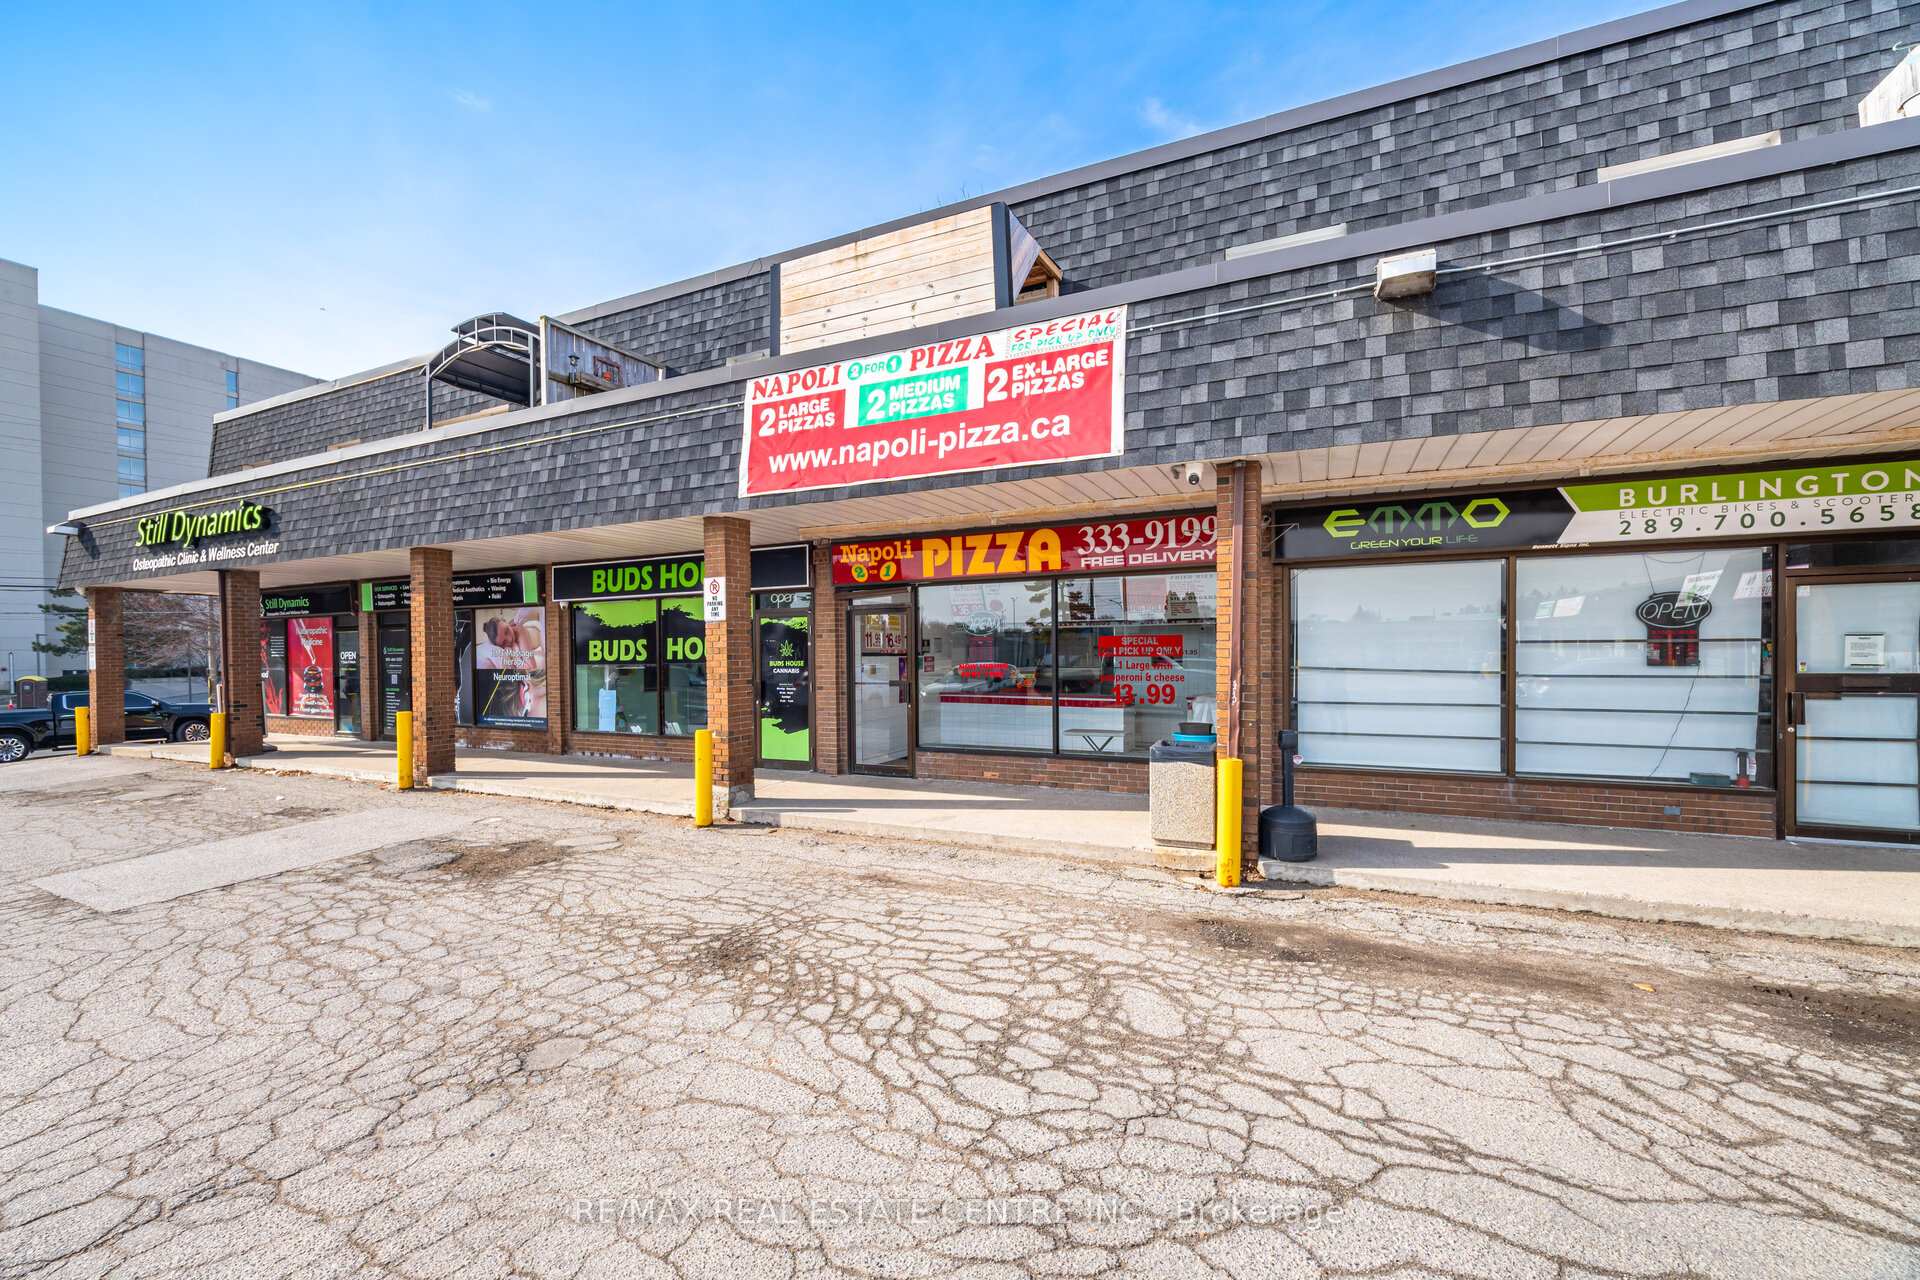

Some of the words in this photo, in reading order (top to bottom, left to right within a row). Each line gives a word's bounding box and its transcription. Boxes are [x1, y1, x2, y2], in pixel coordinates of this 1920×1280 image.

[1013, 312, 1117, 342] SPECIAL
[1037, 336, 1063, 347] PICK
[752, 364, 841, 401] NAPOLI
[864, 361, 886, 374] FOR
[909, 335, 995, 372] PIZZA
[1012, 348, 1109, 381] EX-LARGE
[889, 374, 961, 401] MEDIUM
[987, 368, 1009, 402] 2
[1011, 370, 1085, 399] PIZZAS
[778, 397, 831, 419] LARGE
[866, 388, 887, 421] 2
[888, 392, 955, 417] PIZZAS
[758, 407, 777, 438] 2
[777, 411, 836, 434] PIZZAS
[768, 413, 1071, 474] www.napoli-pizza.ca
[1619, 468, 1920, 507] BURLINGTON
[1322, 498, 1511, 538] EMMO
[1619, 505, 1708, 519] ELECTRIC
[1721, 502, 1777, 514] BIKES
[1790, 500, 1799, 510] &
[1619, 503, 1920, 536] 289.700.5658
[135, 513, 168, 547] Still
[170, 500, 262, 548] Dynamics
[1077, 515, 1218, 555] 333-9199
[839, 540, 915, 567] Napoli
[922, 528, 1062, 578] PIZZA
[1350, 539, 1400, 550] GREEN
[1403, 536, 1443, 547] YOUR
[1446, 534, 1479, 545] LIFE
[132, 556, 176, 572] Osteopathic
[177, 550, 199, 566] Clinic
[200, 549, 206, 562] &
[208, 546, 246, 562] Wellness
[247, 540, 279, 557] Center
[1081, 555, 1125, 568] FREE
[1128, 549, 1217, 565] DELIVERY
[592, 565, 652, 594] BUDS
[660, 561, 704, 590] HO
[265, 600, 278, 609] Still
[279, 596, 310, 611] Dynamics
[1642, 602, 1702, 619] OPEN
[588, 638, 648, 662] BUDS
[666, 636, 707, 661] HO
[1118, 647, 1139, 656] PICK
[1141, 647, 1153, 655] UP
[1155, 646, 1182, 655] ONLY
[1121, 637, 1158, 645] SPECIAL
[340, 651, 357, 660] OPEN
[1125, 661, 1150, 670] Large
[493, 672, 531, 682] Neuroptimal
[1145, 673, 1151, 681] &
[1154, 673, 1185, 682] cheese
[1112, 683, 1176, 705] 13.99
